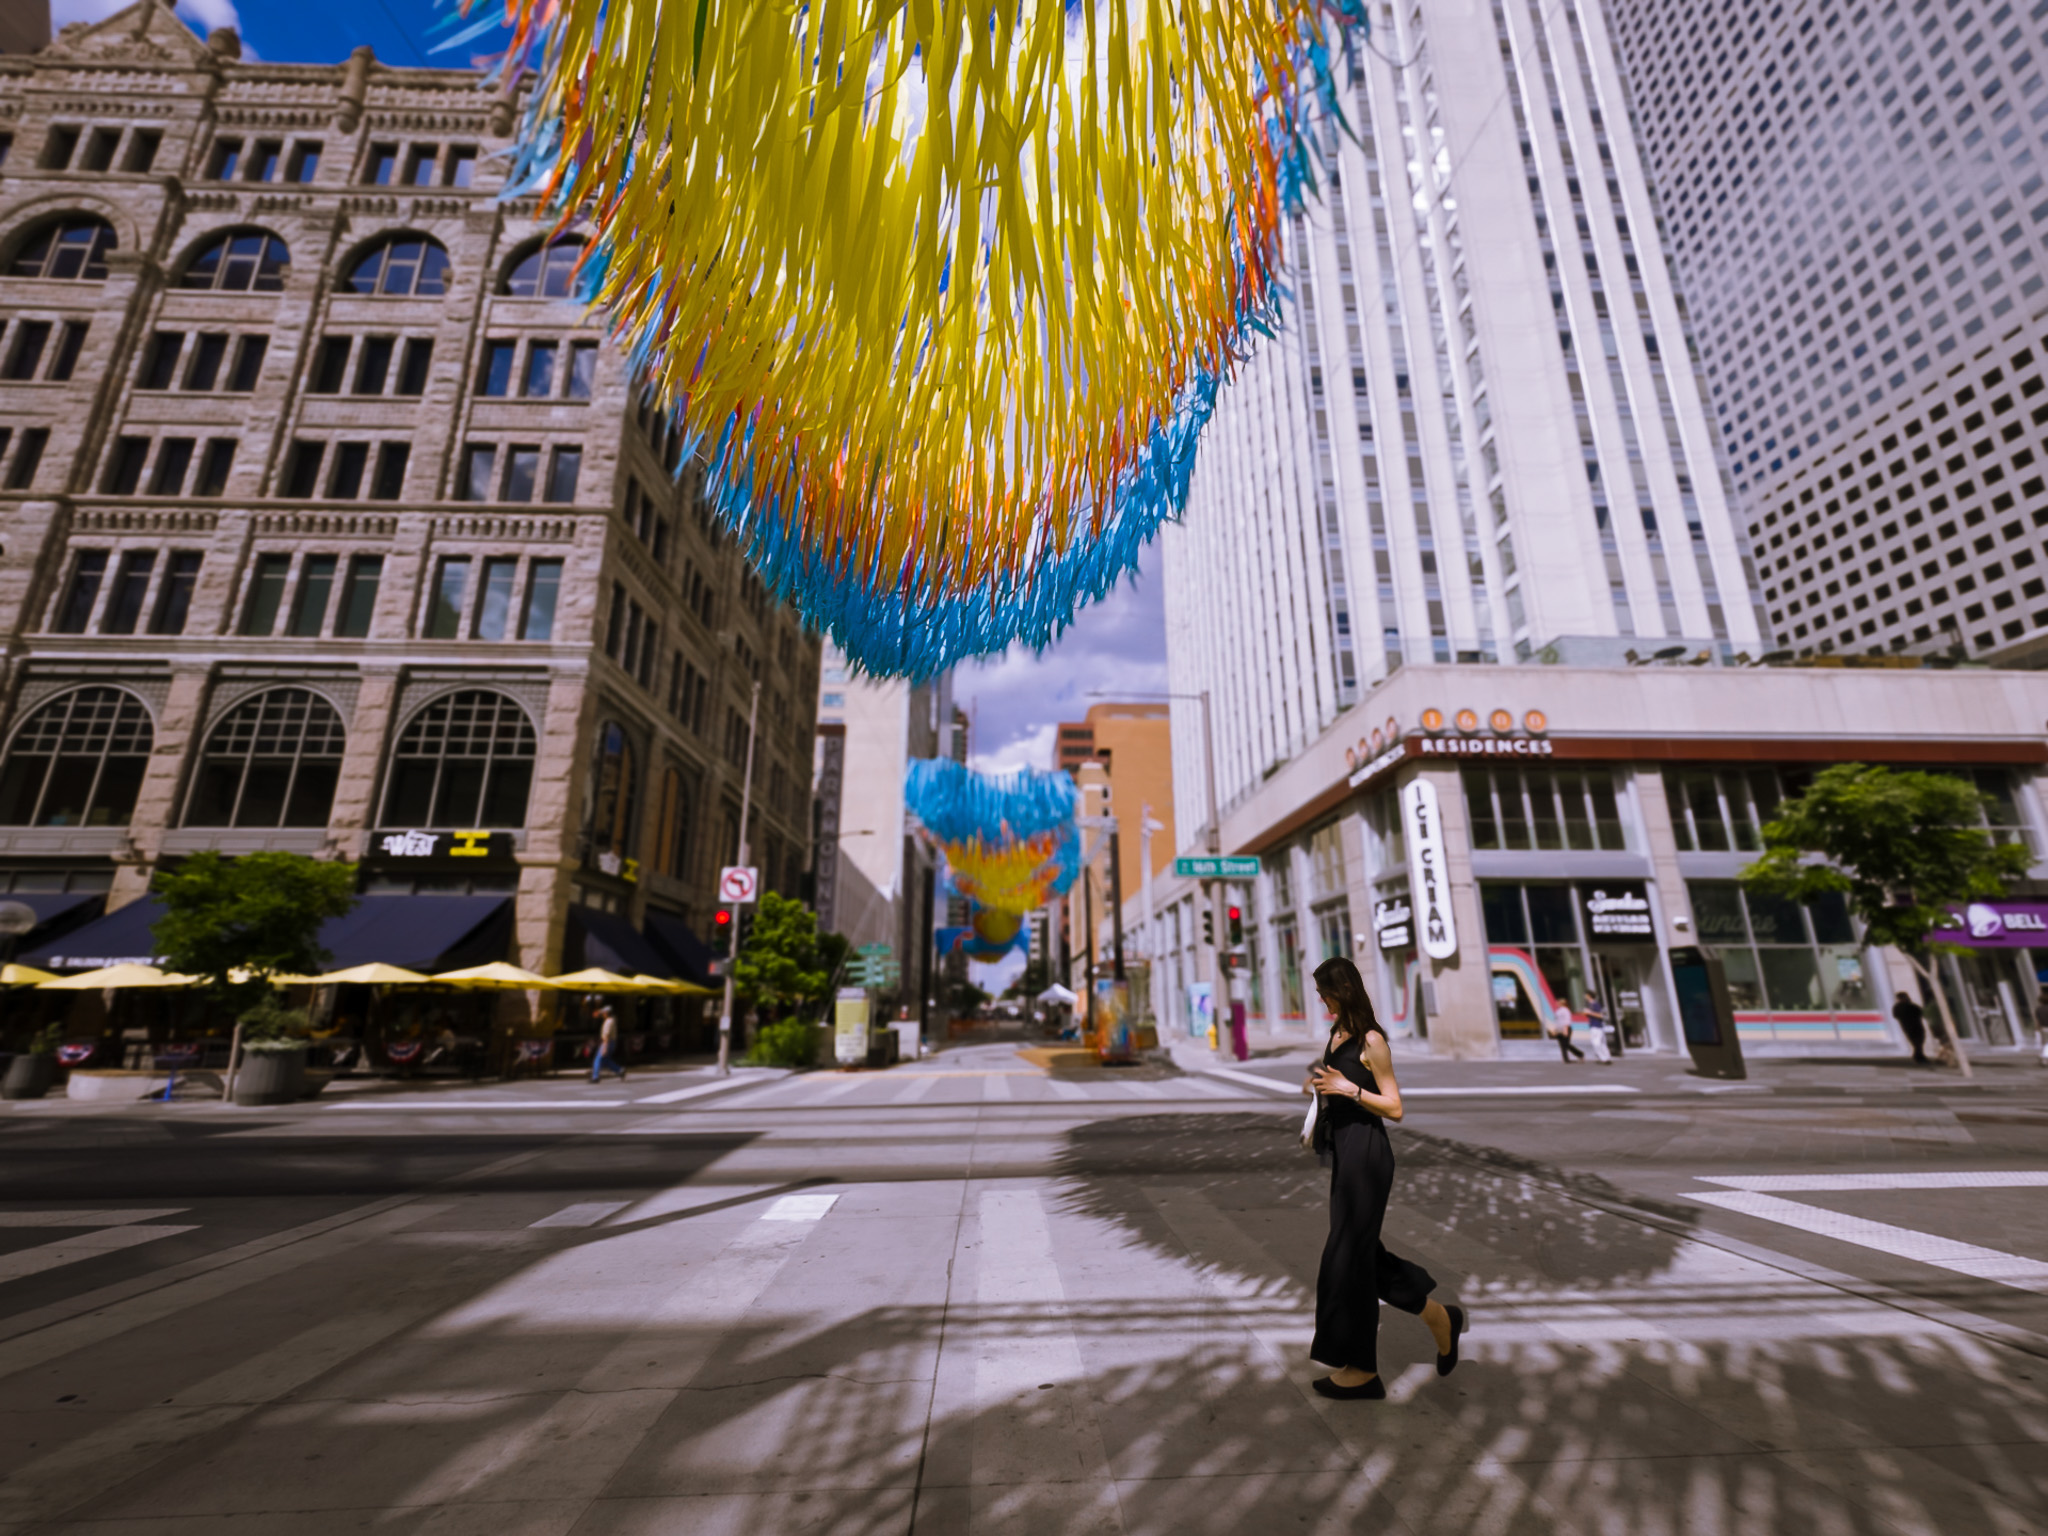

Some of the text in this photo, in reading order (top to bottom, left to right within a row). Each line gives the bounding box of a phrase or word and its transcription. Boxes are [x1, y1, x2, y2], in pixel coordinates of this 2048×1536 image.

[1421, 738, 1553, 754] RESIDENCES
[1220, 859, 1257, 873] Street
[2003, 913, 2047, 929] BELL
